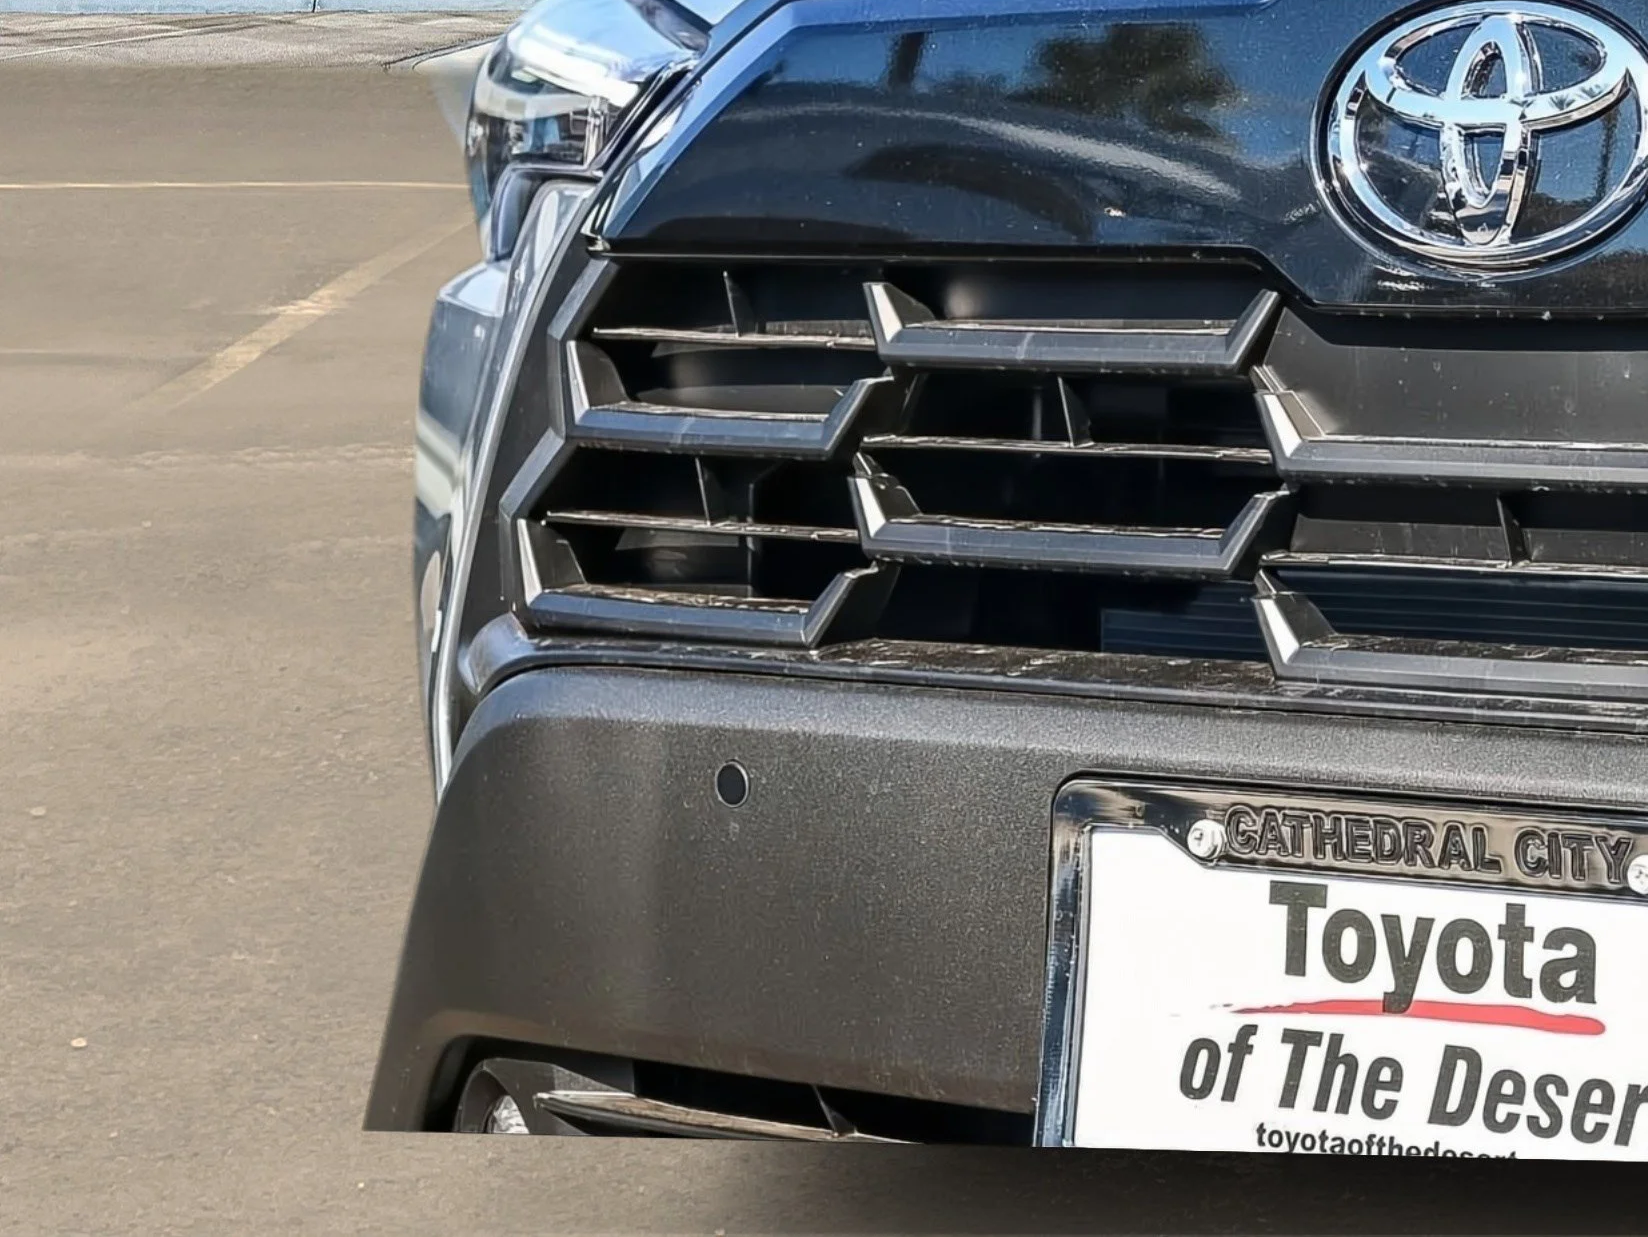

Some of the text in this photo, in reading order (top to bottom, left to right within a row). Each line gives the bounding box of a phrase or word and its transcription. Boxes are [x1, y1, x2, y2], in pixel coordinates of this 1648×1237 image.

[1224, 805, 1635, 884] CATHEDRAL CITY
[1269, 880, 1597, 1013] Toyota
[1179, 1024, 1259, 1103] of
[1278, 1027, 1405, 1121] The
[1256, 1122, 1520, 1159] toyotaofthed
